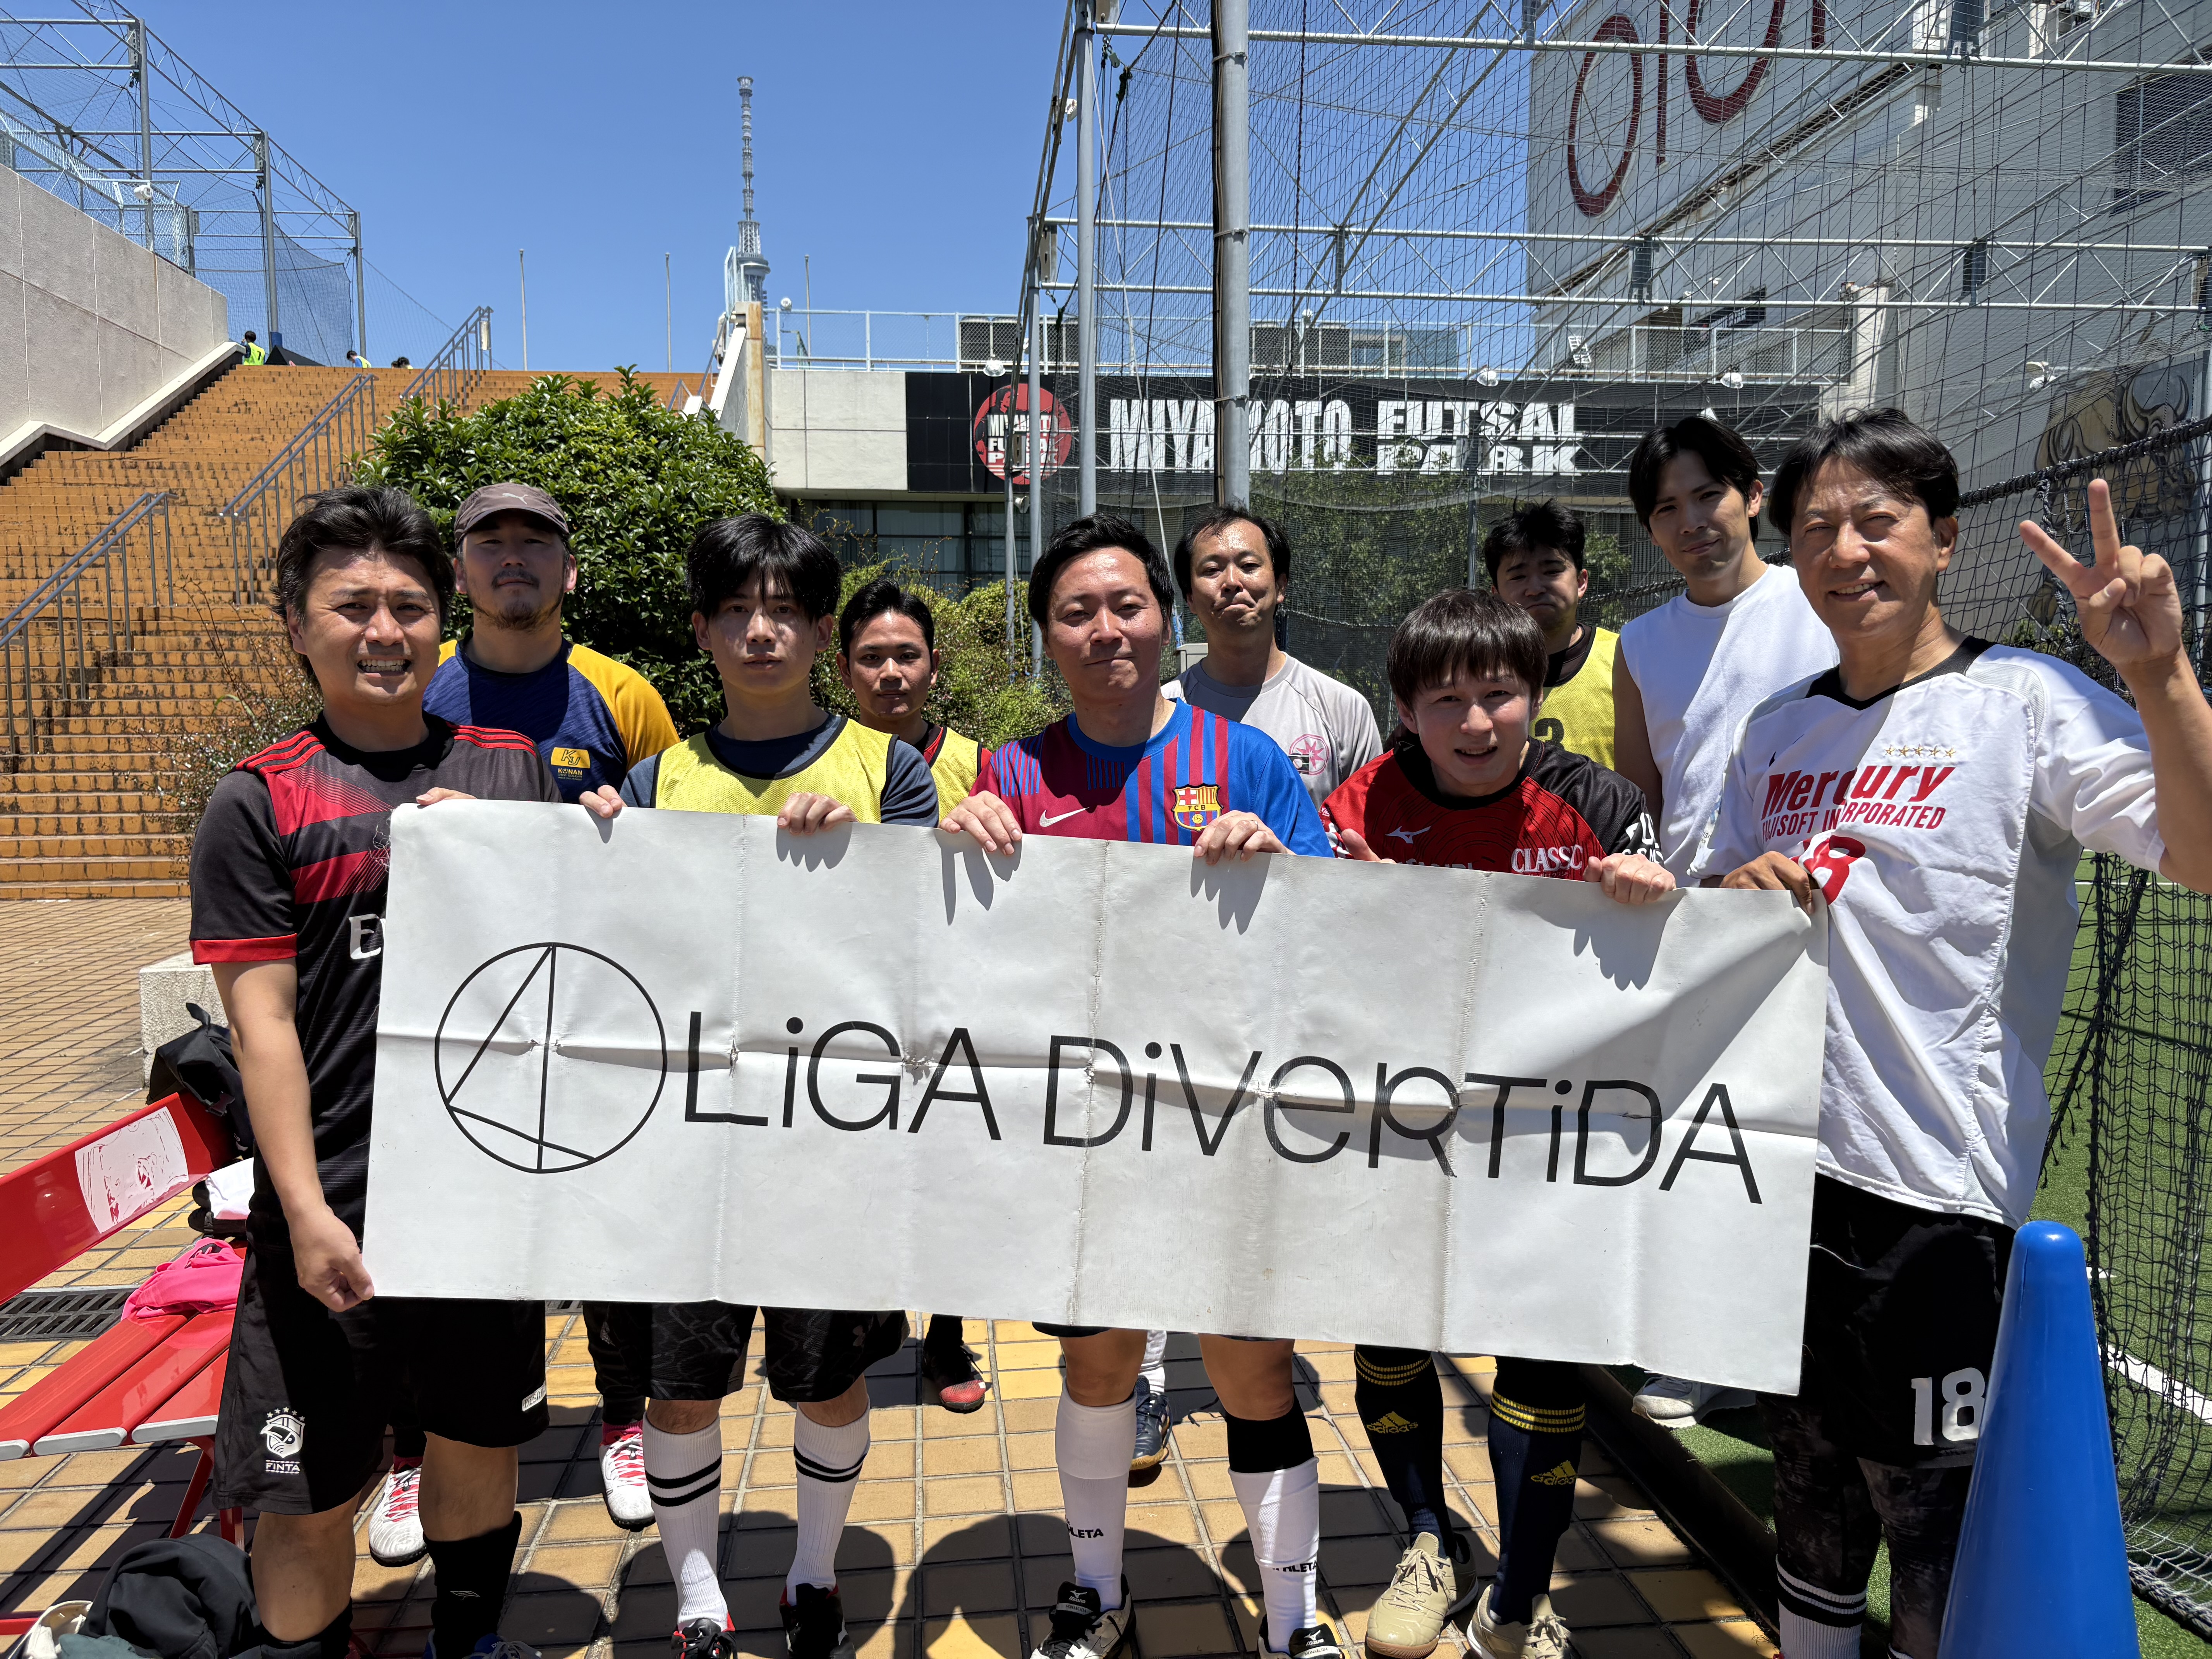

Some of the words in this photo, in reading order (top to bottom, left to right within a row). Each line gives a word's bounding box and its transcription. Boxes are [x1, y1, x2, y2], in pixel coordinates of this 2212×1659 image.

[1377, 400, 1584, 441] FUTSAL
[1377, 444, 1582, 476] PARK
[1761, 765, 1956, 821] Mercury
[349, 913, 386, 960] E
[1911, 1367, 1985, 1446] 18
[1366, 1421, 1419, 1434] adidas
[266, 1463, 300, 1471] FINTA
